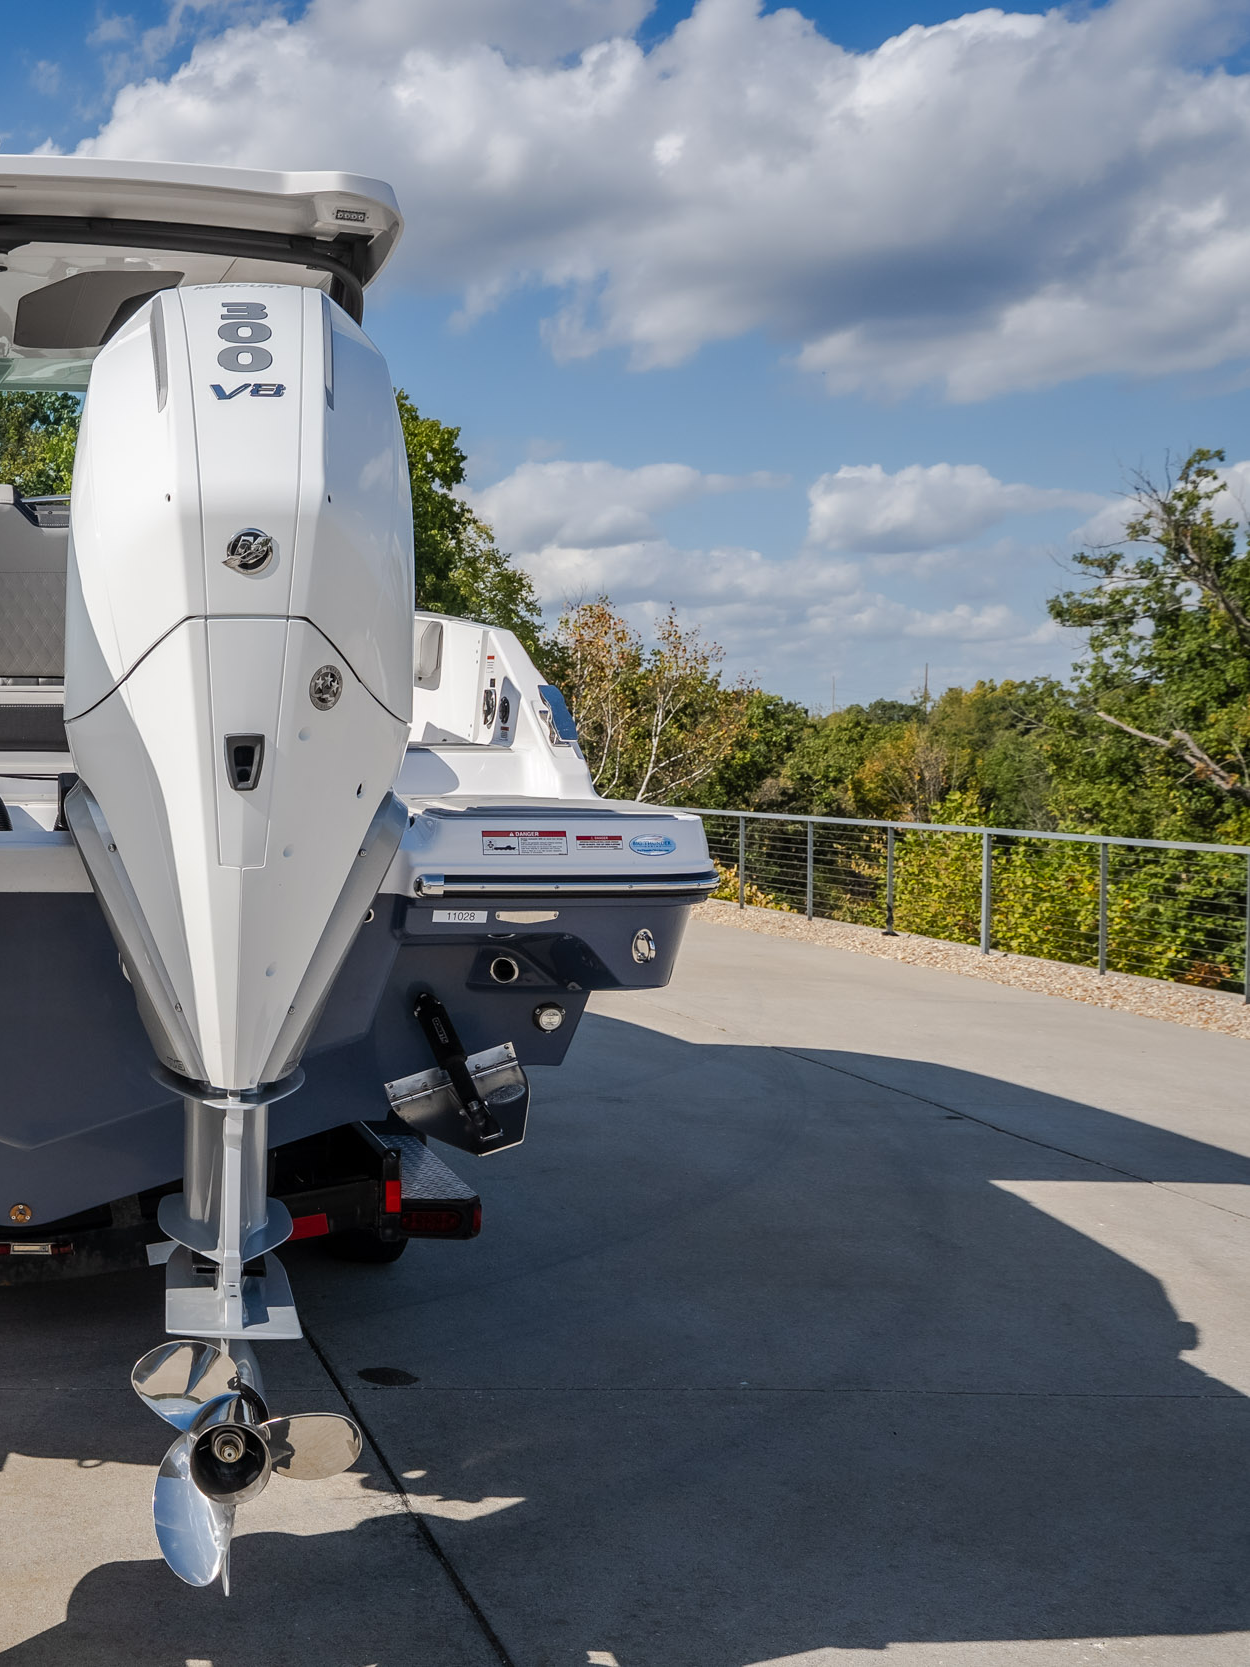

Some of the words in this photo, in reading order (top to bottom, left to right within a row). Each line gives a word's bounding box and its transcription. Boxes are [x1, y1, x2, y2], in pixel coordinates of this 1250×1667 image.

[193, 283, 288, 291] MERCURY
[217, 302, 273, 372] 300
[447, 911, 476, 922] 11028
